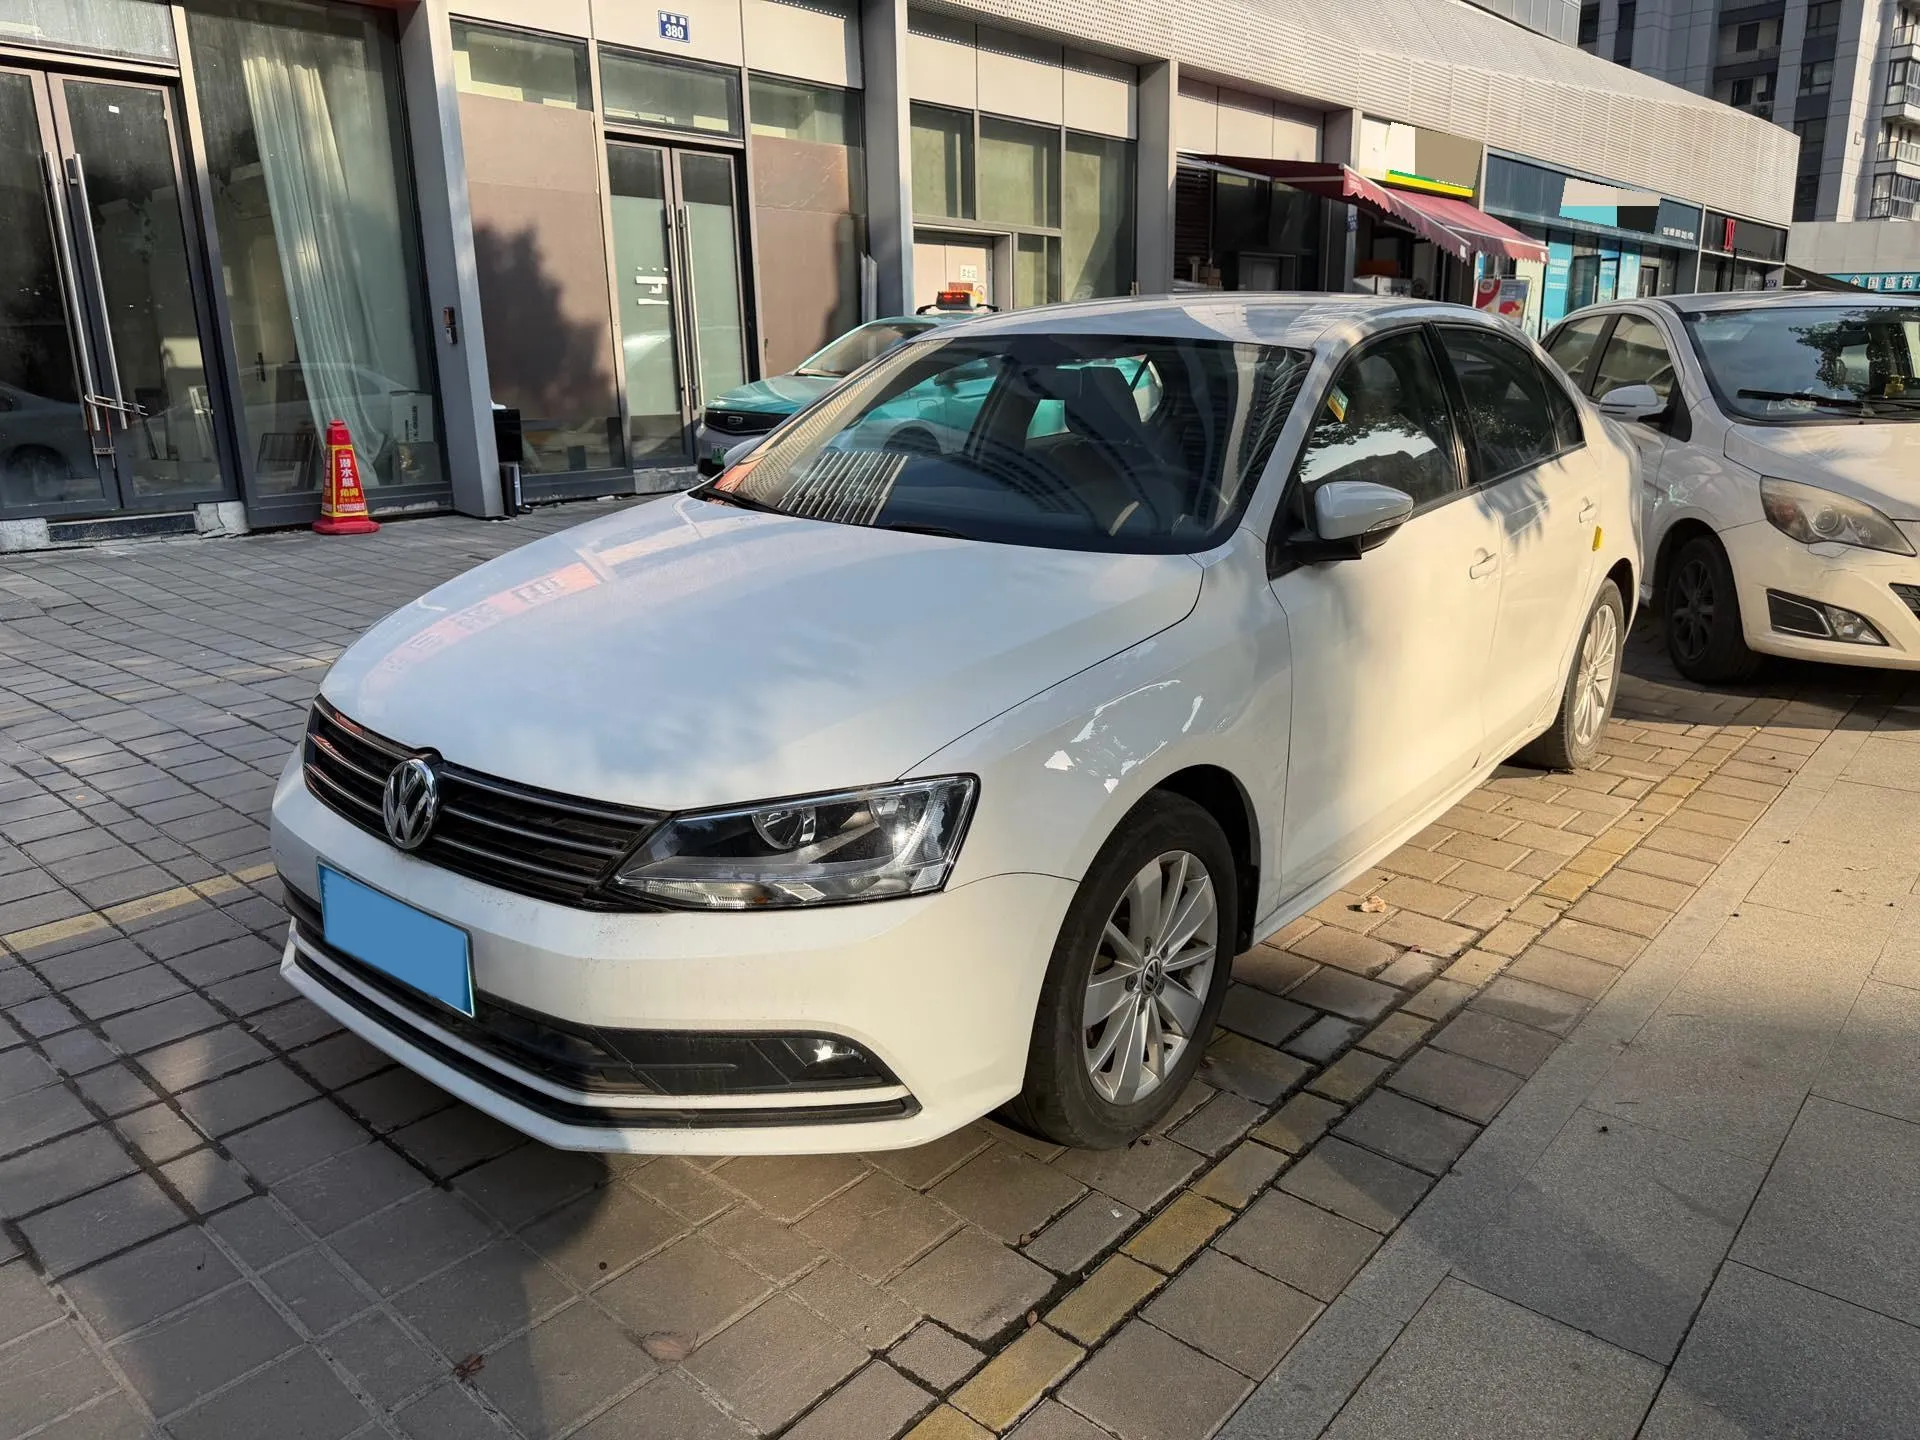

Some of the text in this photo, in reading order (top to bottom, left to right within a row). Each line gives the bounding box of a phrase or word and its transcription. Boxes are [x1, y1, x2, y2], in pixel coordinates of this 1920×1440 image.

[666, 24, 684, 38] 380
[1868, 275, 1920, 290] 国盛药
[339, 458, 354, 487] 潜水艇
